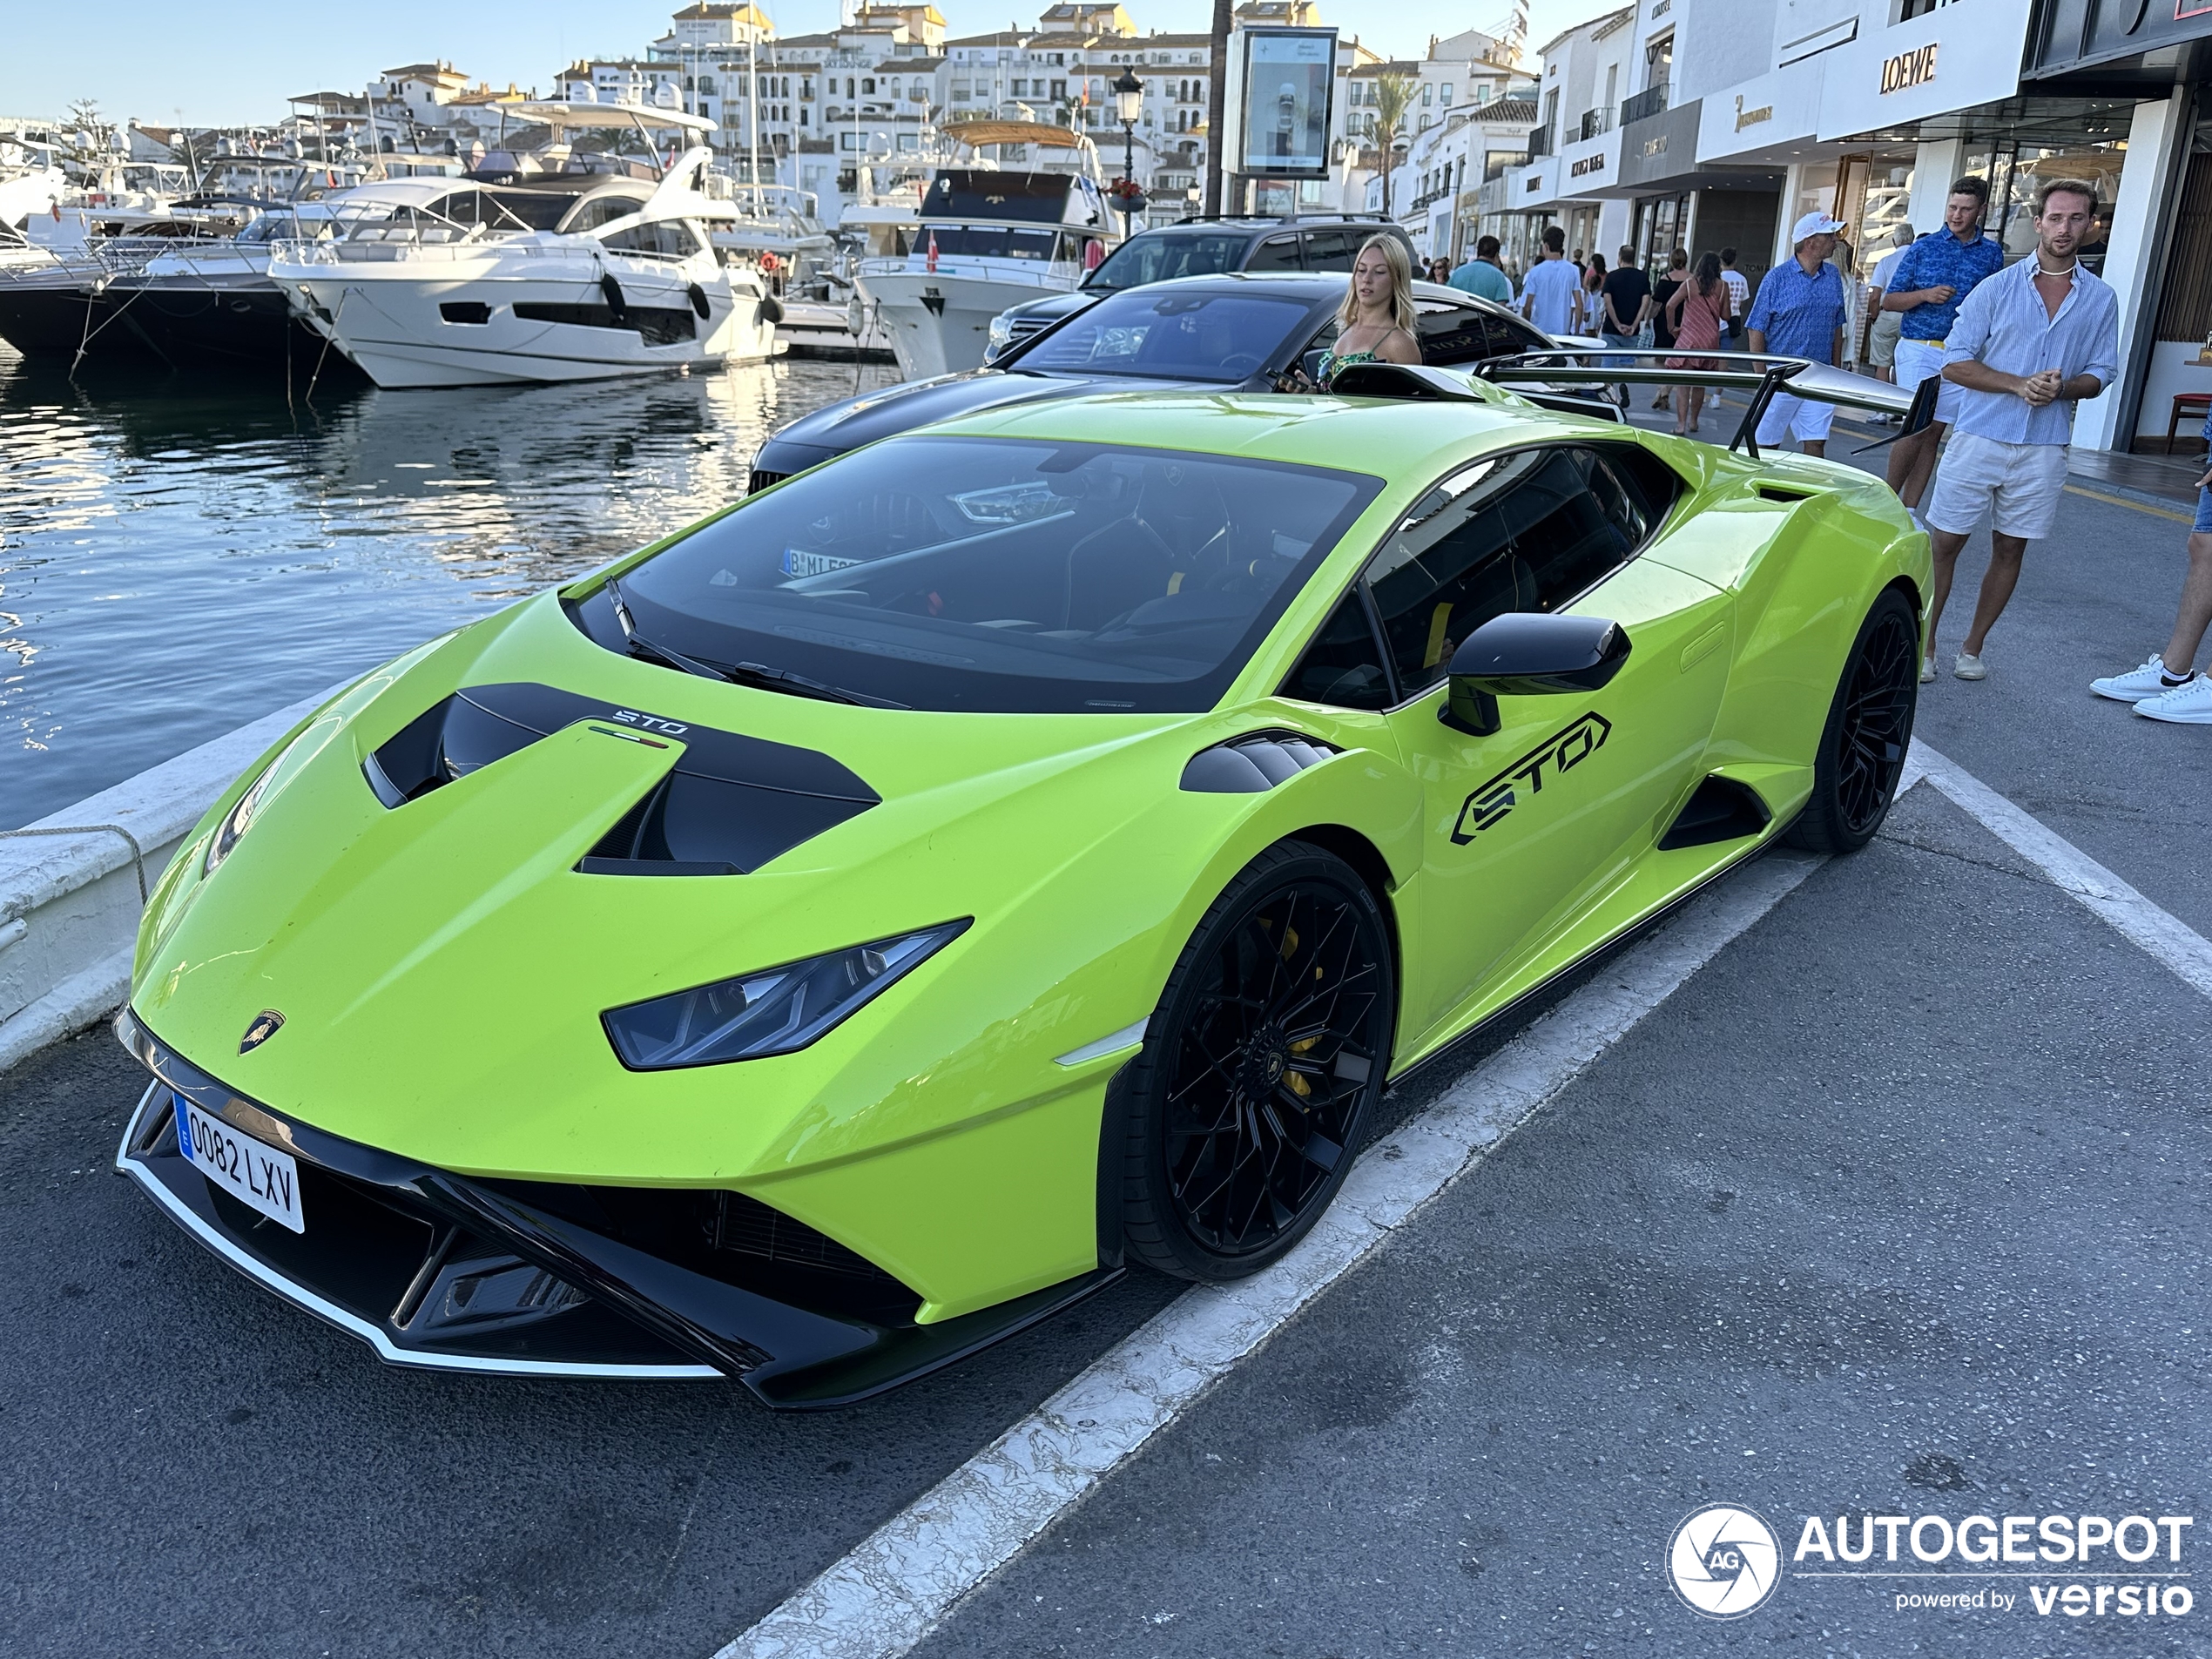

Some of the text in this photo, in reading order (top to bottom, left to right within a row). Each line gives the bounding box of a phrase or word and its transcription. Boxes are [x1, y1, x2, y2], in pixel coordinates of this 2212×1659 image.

[1879, 43, 1937, 95] LOEWE
[612, 710, 688, 735] STO
[1473, 725, 1593, 831] STO
[190, 1111, 291, 1212] 0082 LXV
